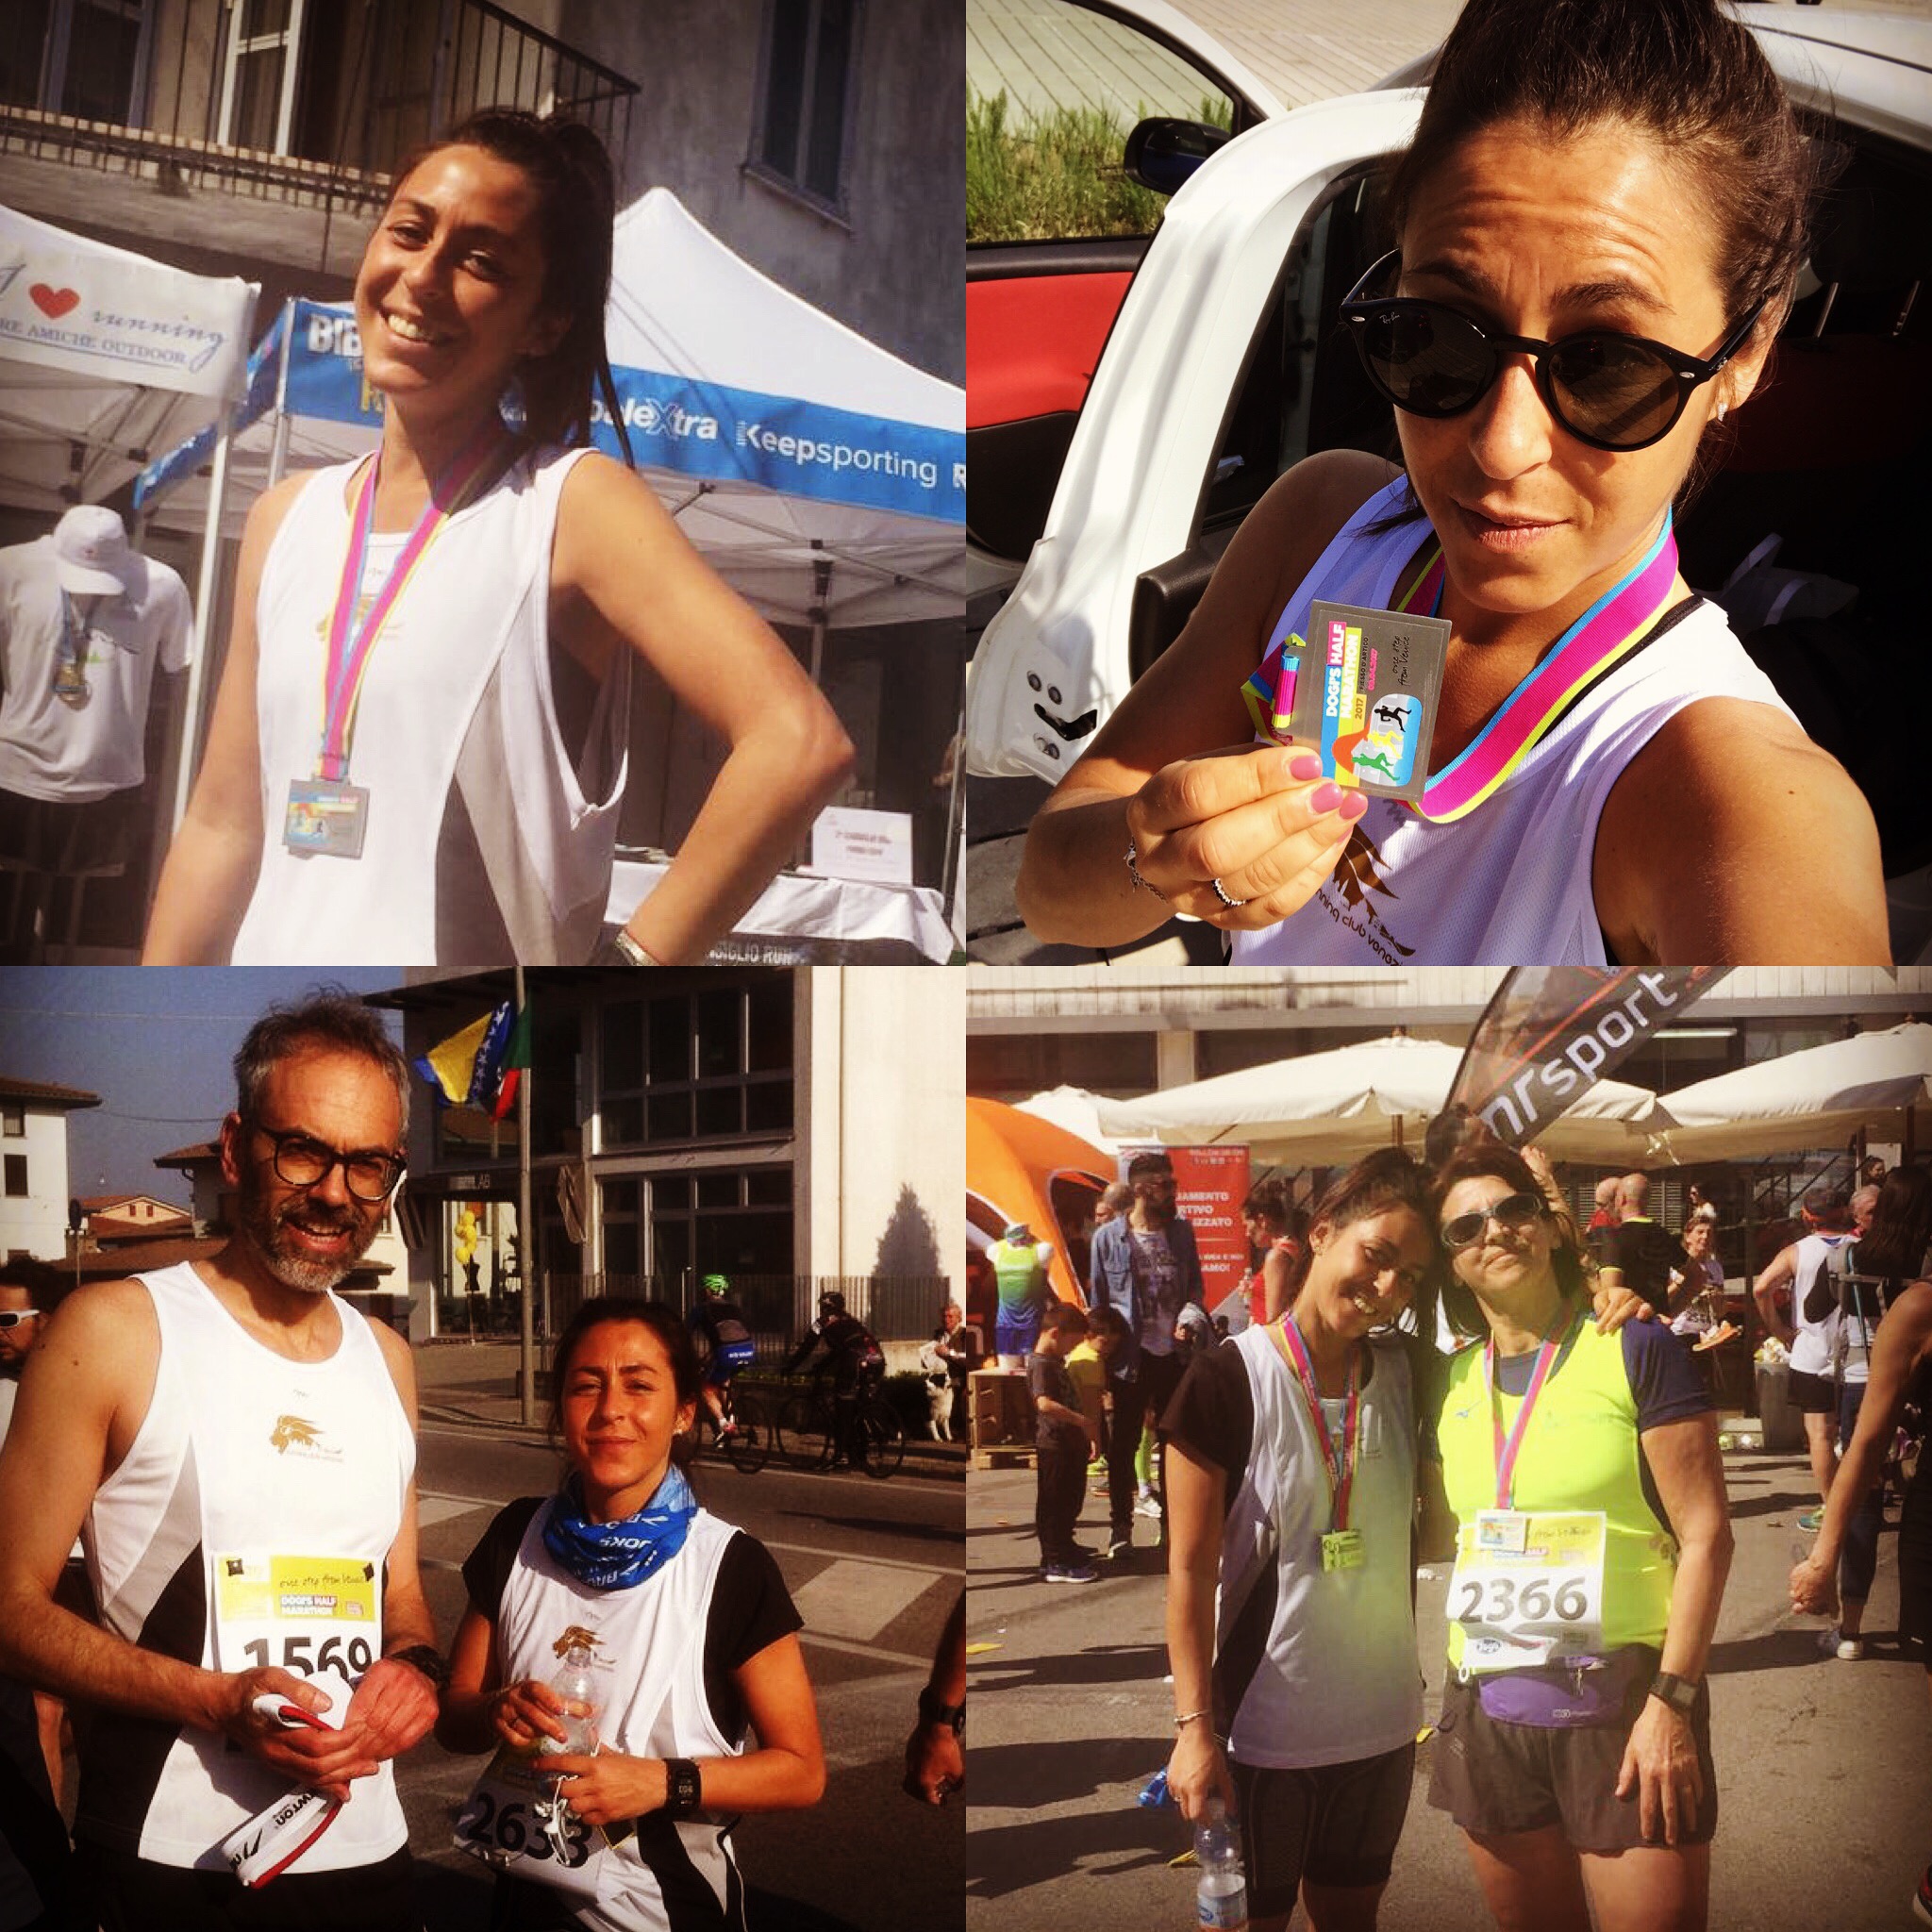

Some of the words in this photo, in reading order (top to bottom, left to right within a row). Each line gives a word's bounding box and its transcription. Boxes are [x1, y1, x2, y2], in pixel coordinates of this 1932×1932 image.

[27, 325, 96, 348] AMICHE
[102, 338, 186, 363] OUTDOOR
[736, 421, 938, 489] Keepsporting
[1329, 624, 1345, 664] HALF
[1340, 634, 1358, 719] MARATHON
[1355, 697, 1364, 720] 2017
[1341, 916, 1366, 938] club
[1367, 934, 1404, 966] venez
[1459, 1577, 1589, 1624] 2366
